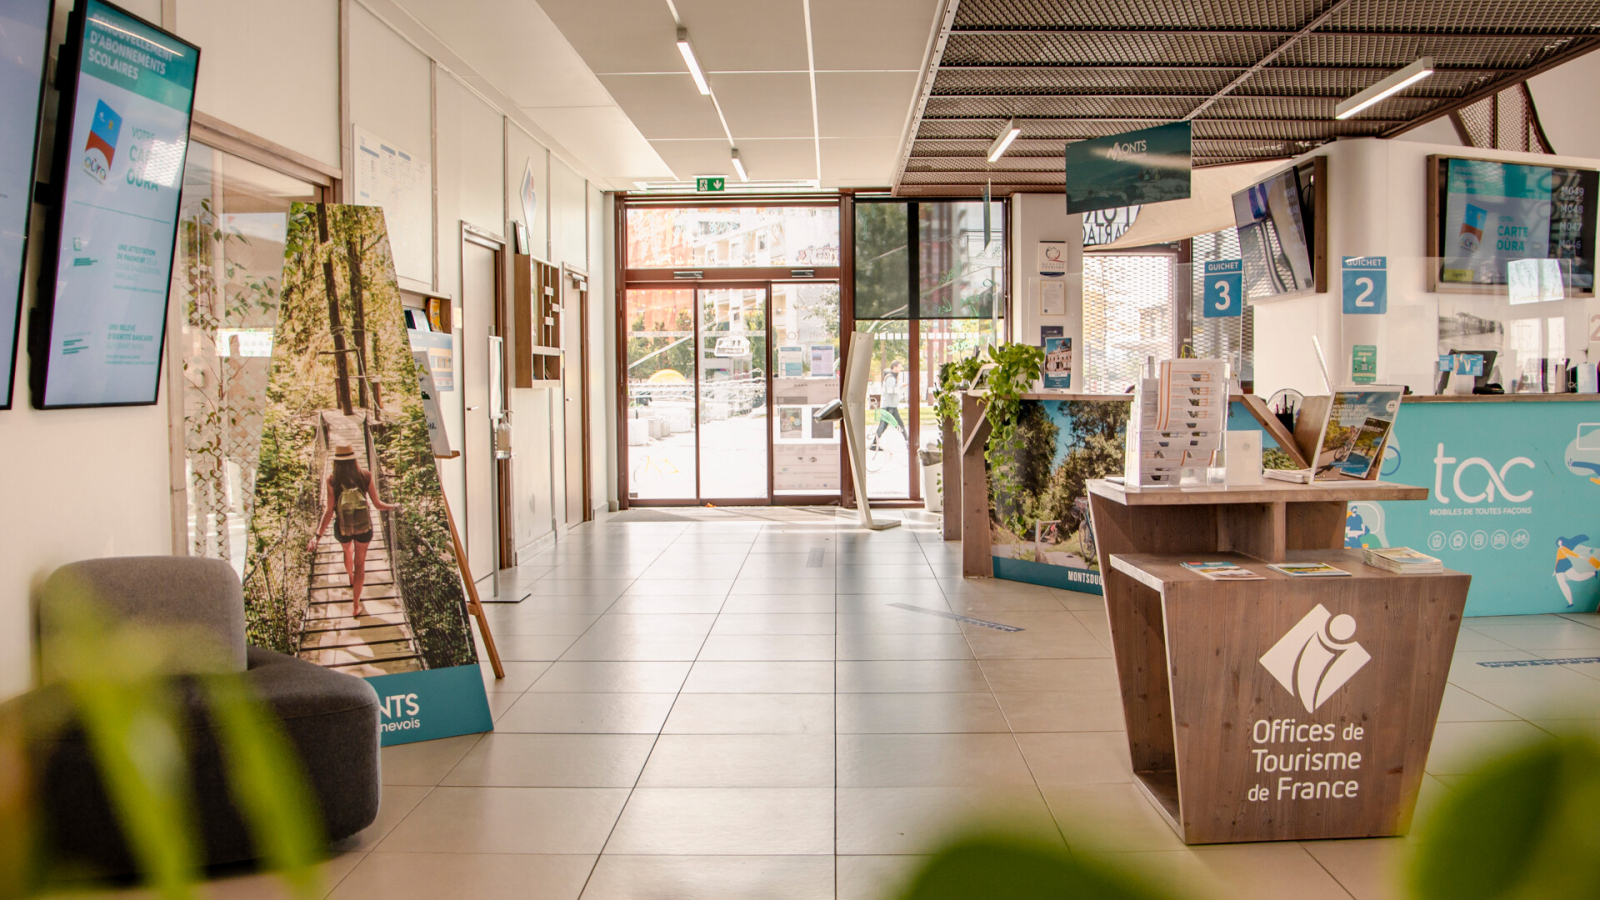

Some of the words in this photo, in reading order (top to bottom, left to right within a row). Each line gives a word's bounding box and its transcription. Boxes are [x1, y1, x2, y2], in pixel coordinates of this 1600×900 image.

[88, 48, 139, 80] SCOLAIRES
[89, 31, 166, 75] D'ABONNEMENTS
[1106, 140, 1147, 161] MONTS
[1497, 225, 1529, 237] CARTE
[1208, 261, 1239, 271] GUICHET
[1346, 258, 1383, 267] GUICHET
[1214, 280, 1231, 310] 3
[1355, 277, 1375, 307] 2
[1433, 442, 1535, 504] tac
[1430, 508, 1462, 517] MOBILES
[1463, 508, 1474, 516] DE
[1475, 507, 1502, 515] TOUTES
[1503, 506, 1533, 516] FAÇONS
[1252, 718, 1336, 744] Offices
[1342, 722, 1365, 741] de
[1251, 747, 1362, 773] Tourisme
[1247, 783, 1270, 801] de
[1277, 776, 1359, 801] France
